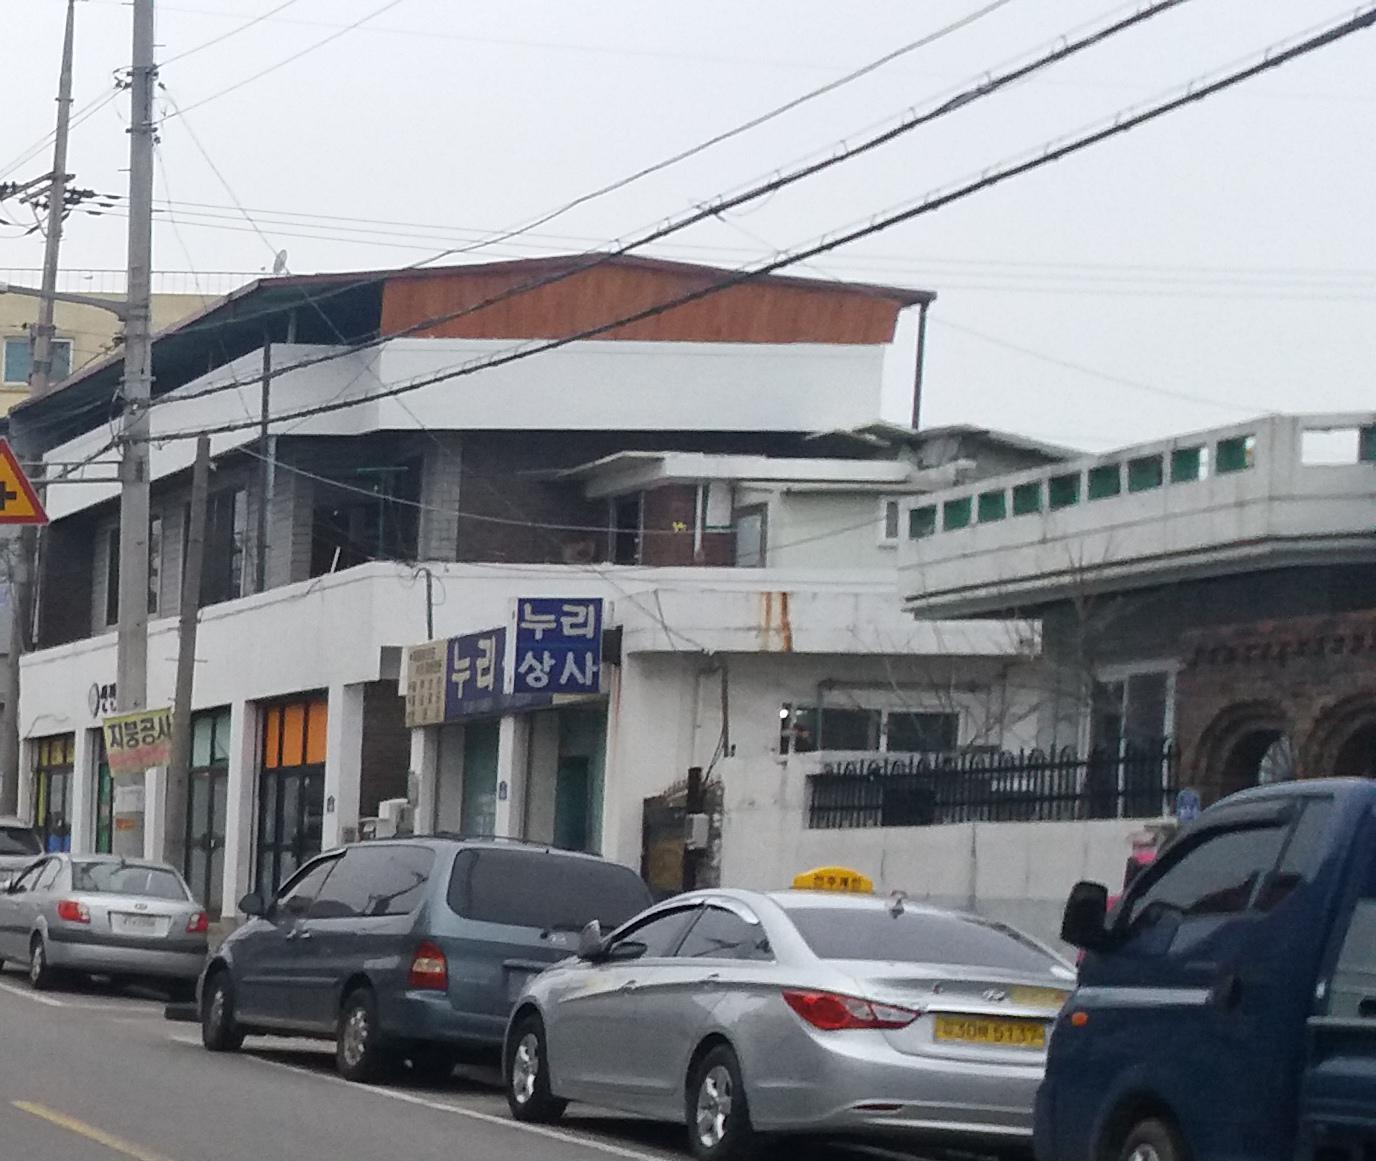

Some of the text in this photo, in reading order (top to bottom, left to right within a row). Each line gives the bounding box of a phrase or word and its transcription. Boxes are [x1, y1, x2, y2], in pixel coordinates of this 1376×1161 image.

[519, 602, 596, 641] 누리
[451, 634, 496, 700] 누리
[517, 650, 599, 689] 상사
[106, 714, 174, 750] 지붕공사
